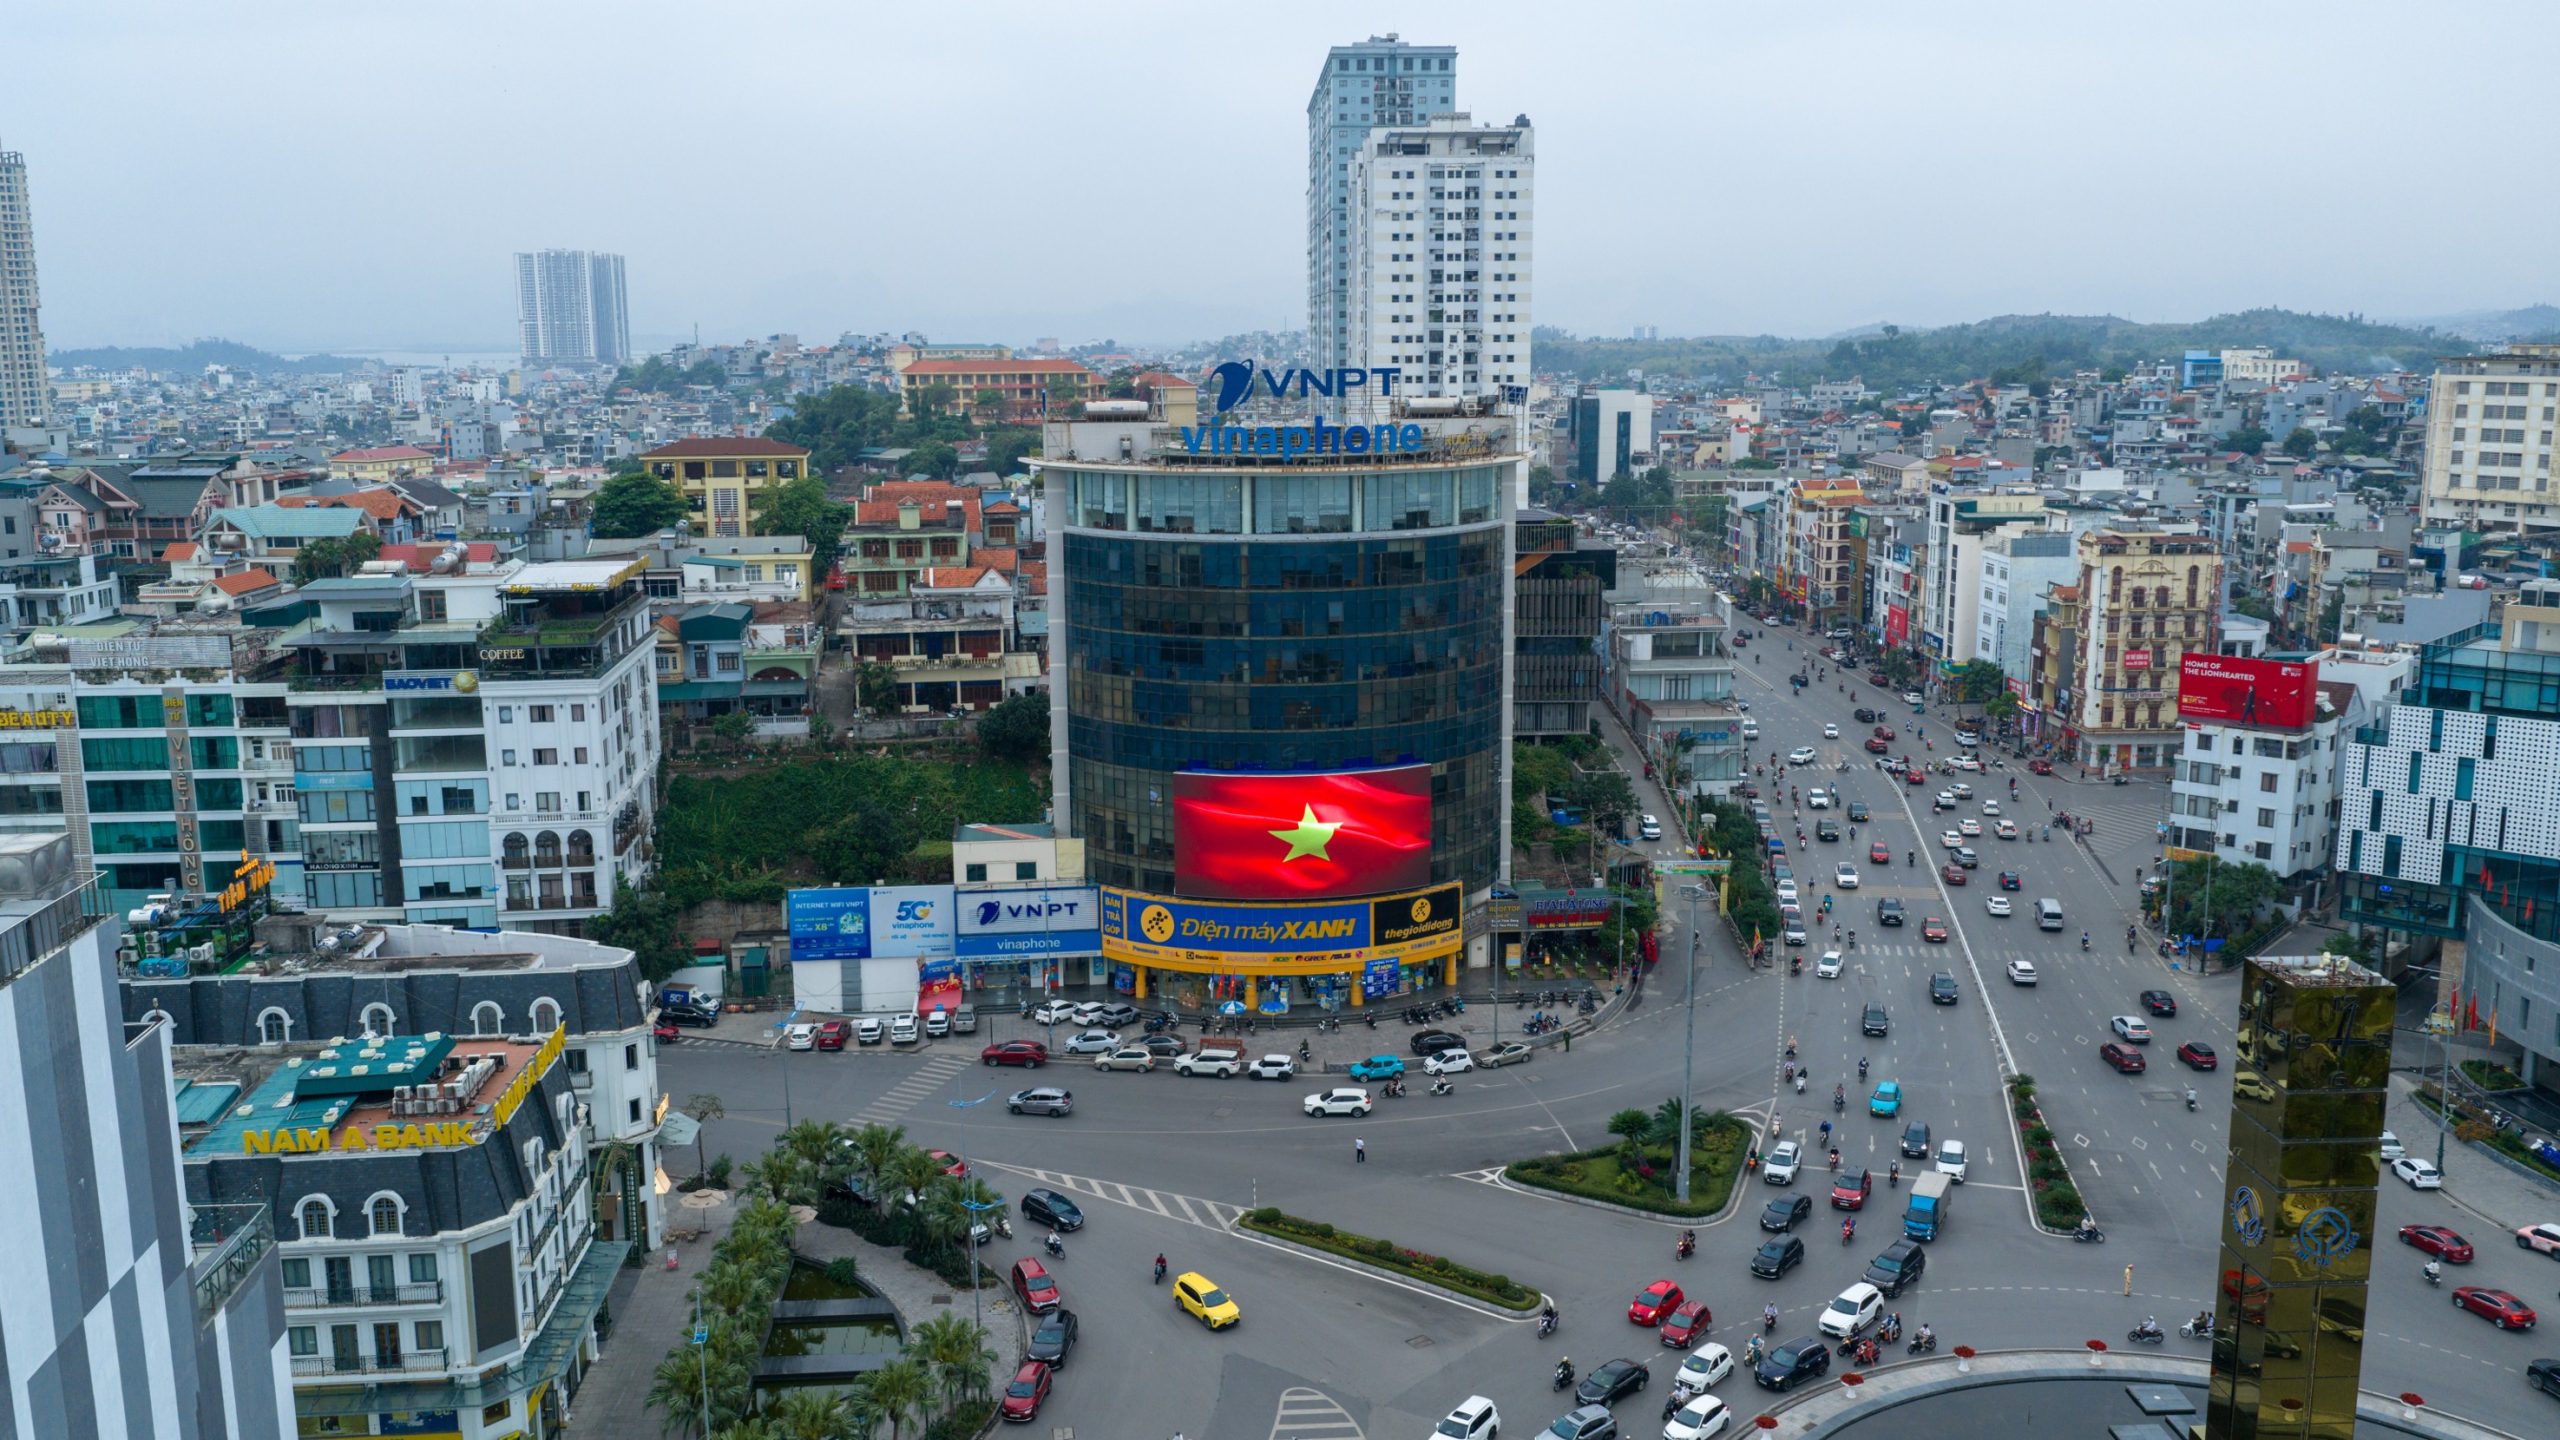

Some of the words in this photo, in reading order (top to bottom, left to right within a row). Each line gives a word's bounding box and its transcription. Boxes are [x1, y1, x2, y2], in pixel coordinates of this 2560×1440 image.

[1261, 367, 1401, 398] VNPT
[1180, 415, 1423, 463] vinaphone
[479, 649, 524, 662] COFFEE
[2185, 660, 2208, 669] HOME
[2184, 667, 2199, 676] THE
[2200, 669, 2255, 681] LIONHEARTED
[1007, 902, 1078, 918] VNPT
[892, 922, 935, 930] vinaphone
[1105, 924, 1120, 935] GÓP
[1181, 918, 1230, 942] Điện
[1280, 918, 1356, 939] XANH
[1384, 917, 1453, 940] thegioididong
[997, 938, 1061, 951] vinaphone
[243, 1130, 330, 1153] NAM
[340, 1126, 367, 1150] A
[375, 1121, 478, 1148] BANK
